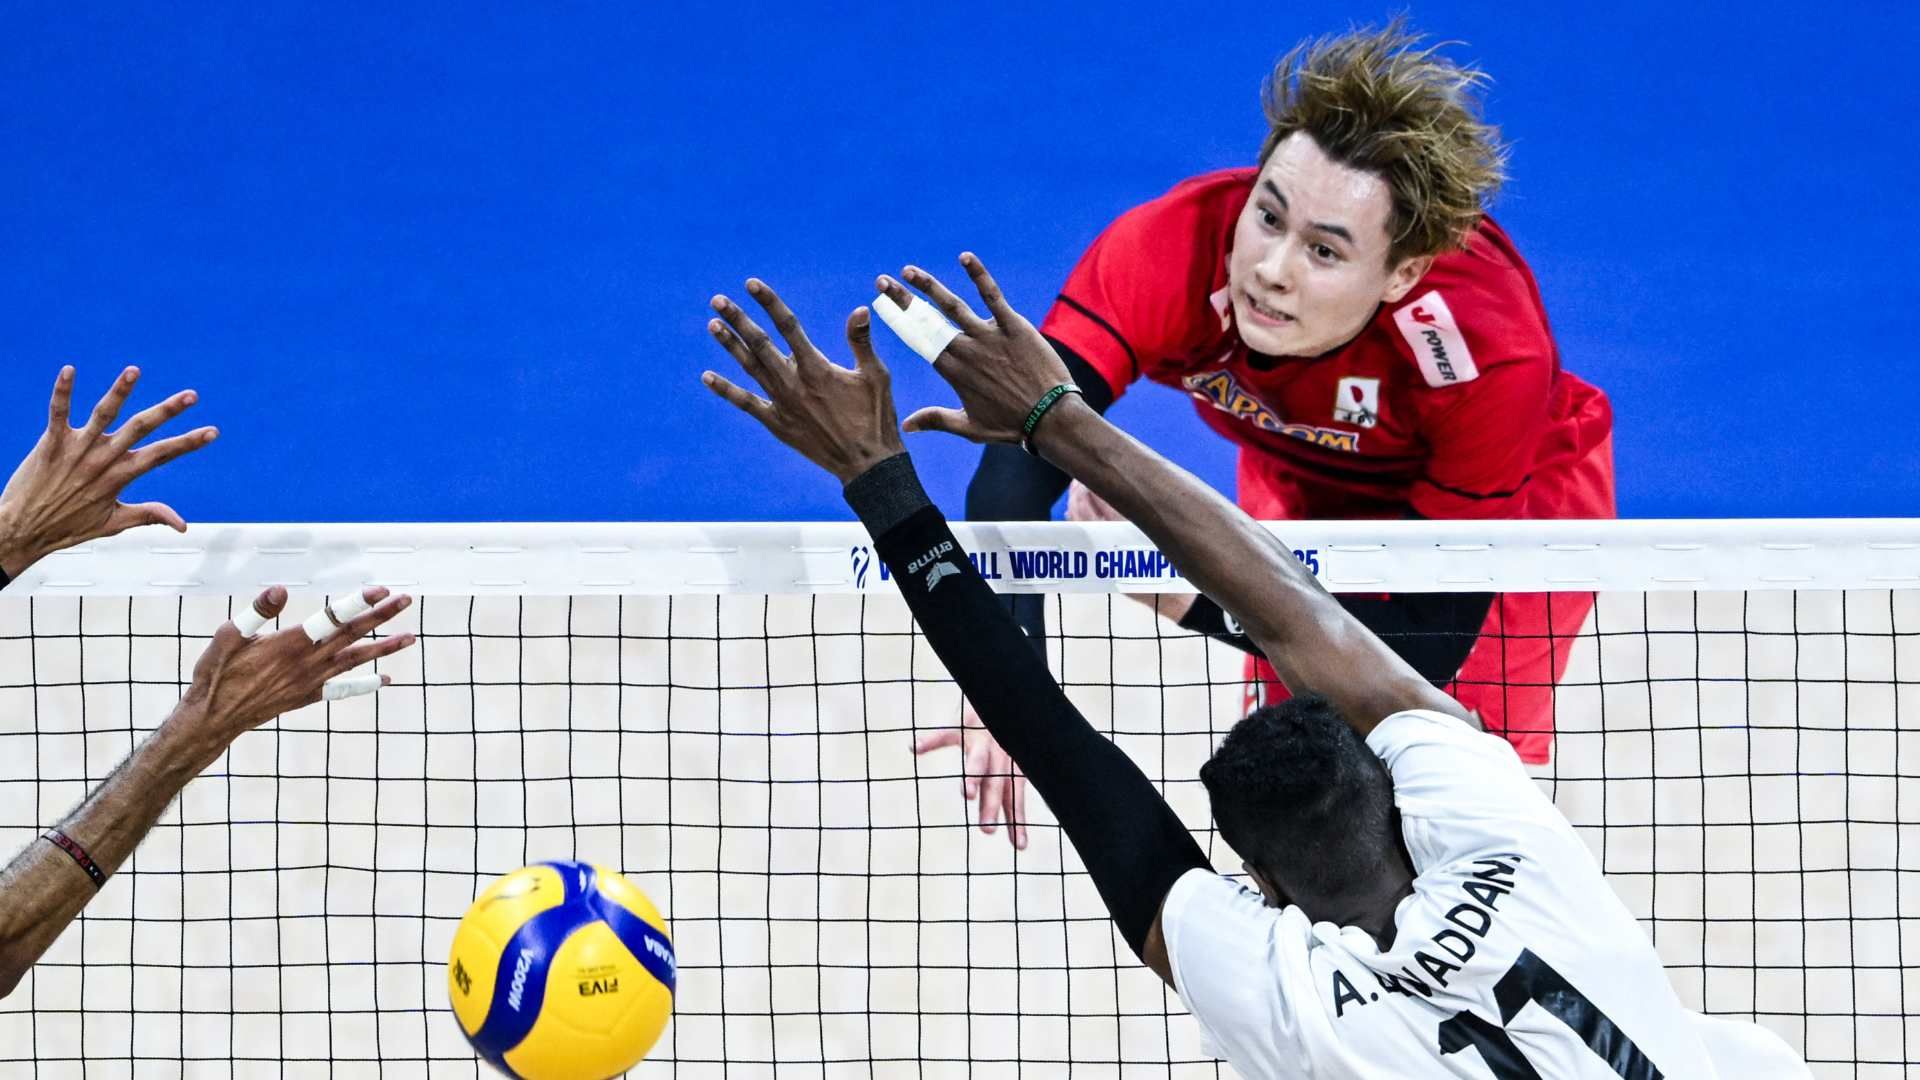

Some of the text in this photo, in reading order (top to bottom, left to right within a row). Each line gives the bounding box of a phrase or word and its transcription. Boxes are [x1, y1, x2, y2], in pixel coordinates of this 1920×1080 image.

[1421, 329, 1457, 381] POWER
[907, 541, 954, 574] erima
[1009, 550, 1088, 579] WORLD
[508, 948, 535, 1012] V200W
[1332, 969, 1379, 1019] A.
[1438, 947, 1665, 1080] 11
